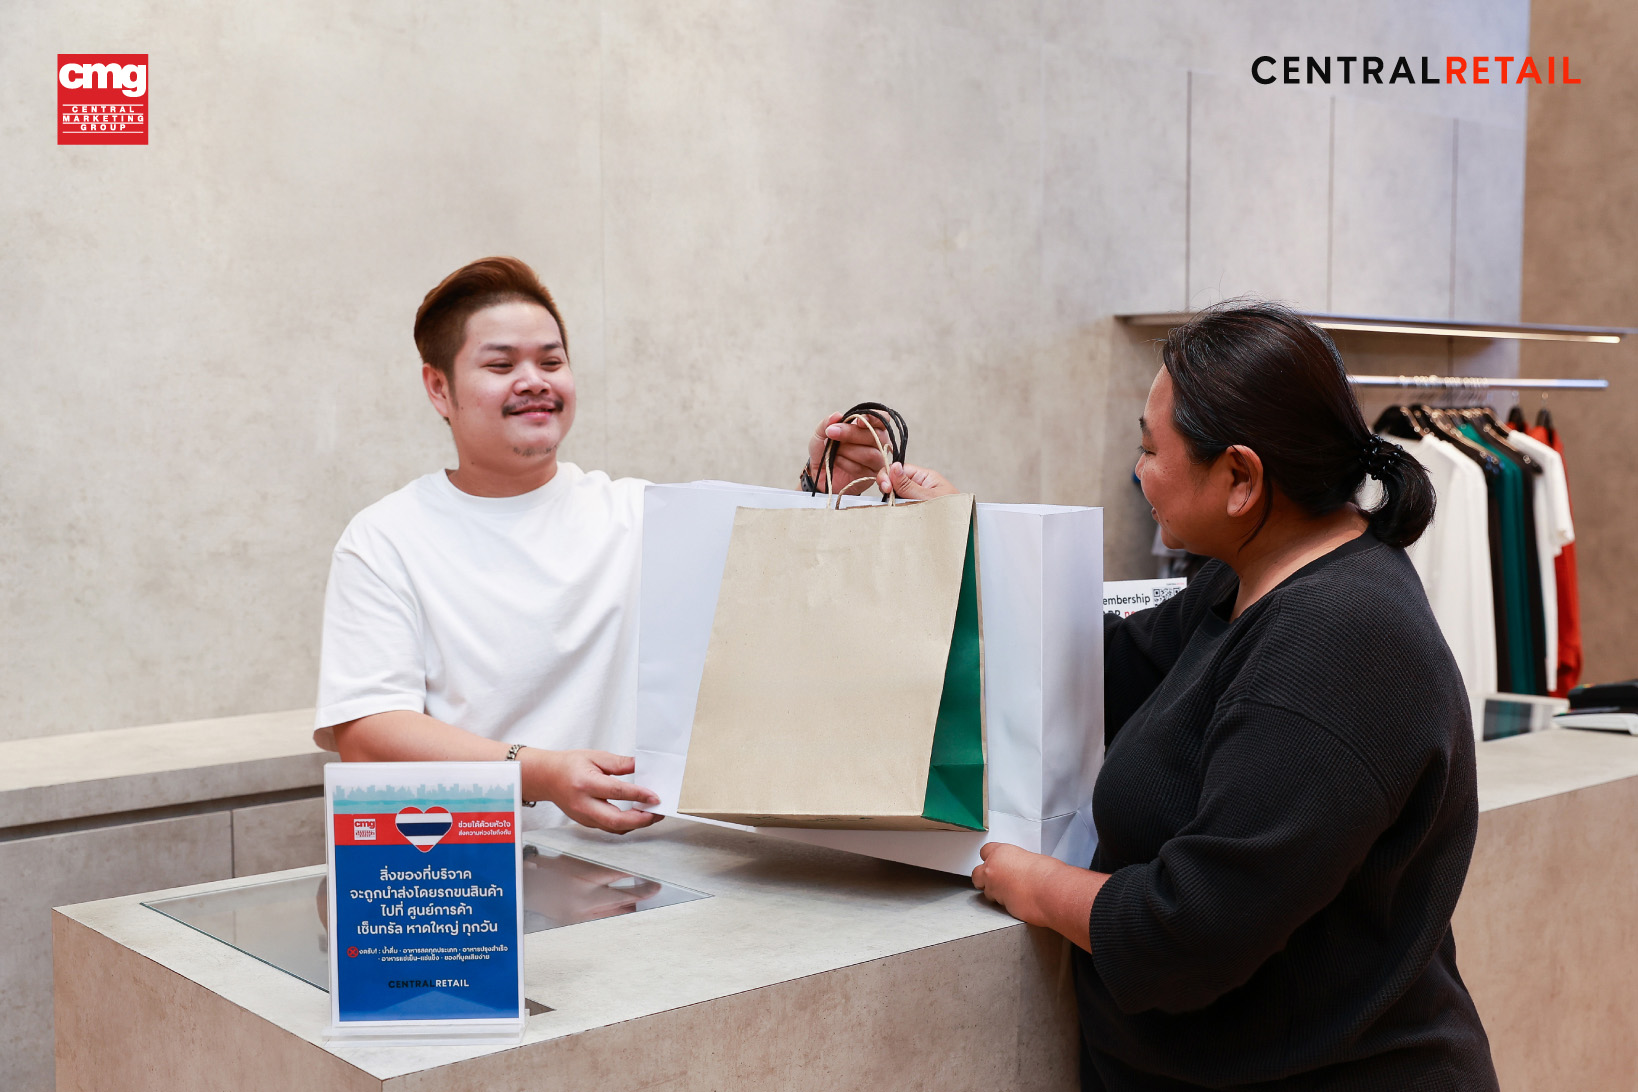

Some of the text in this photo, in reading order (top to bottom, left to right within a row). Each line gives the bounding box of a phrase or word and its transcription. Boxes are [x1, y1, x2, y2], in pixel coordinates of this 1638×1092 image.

[1103, 593, 1151, 605] embership
[354, 820, 376, 829] cmg
[379, 865, 472, 881] สิ่งของที่บริจาค
[350, 884, 503, 903] จะถูกนำส่งโดยรถขนสินค้า
[380, 901, 473, 920] ไปที่ ศูนย์การค้า
[357, 920, 498, 936] เซ็นทรัล หาดใหญ่ ทุกวัน
